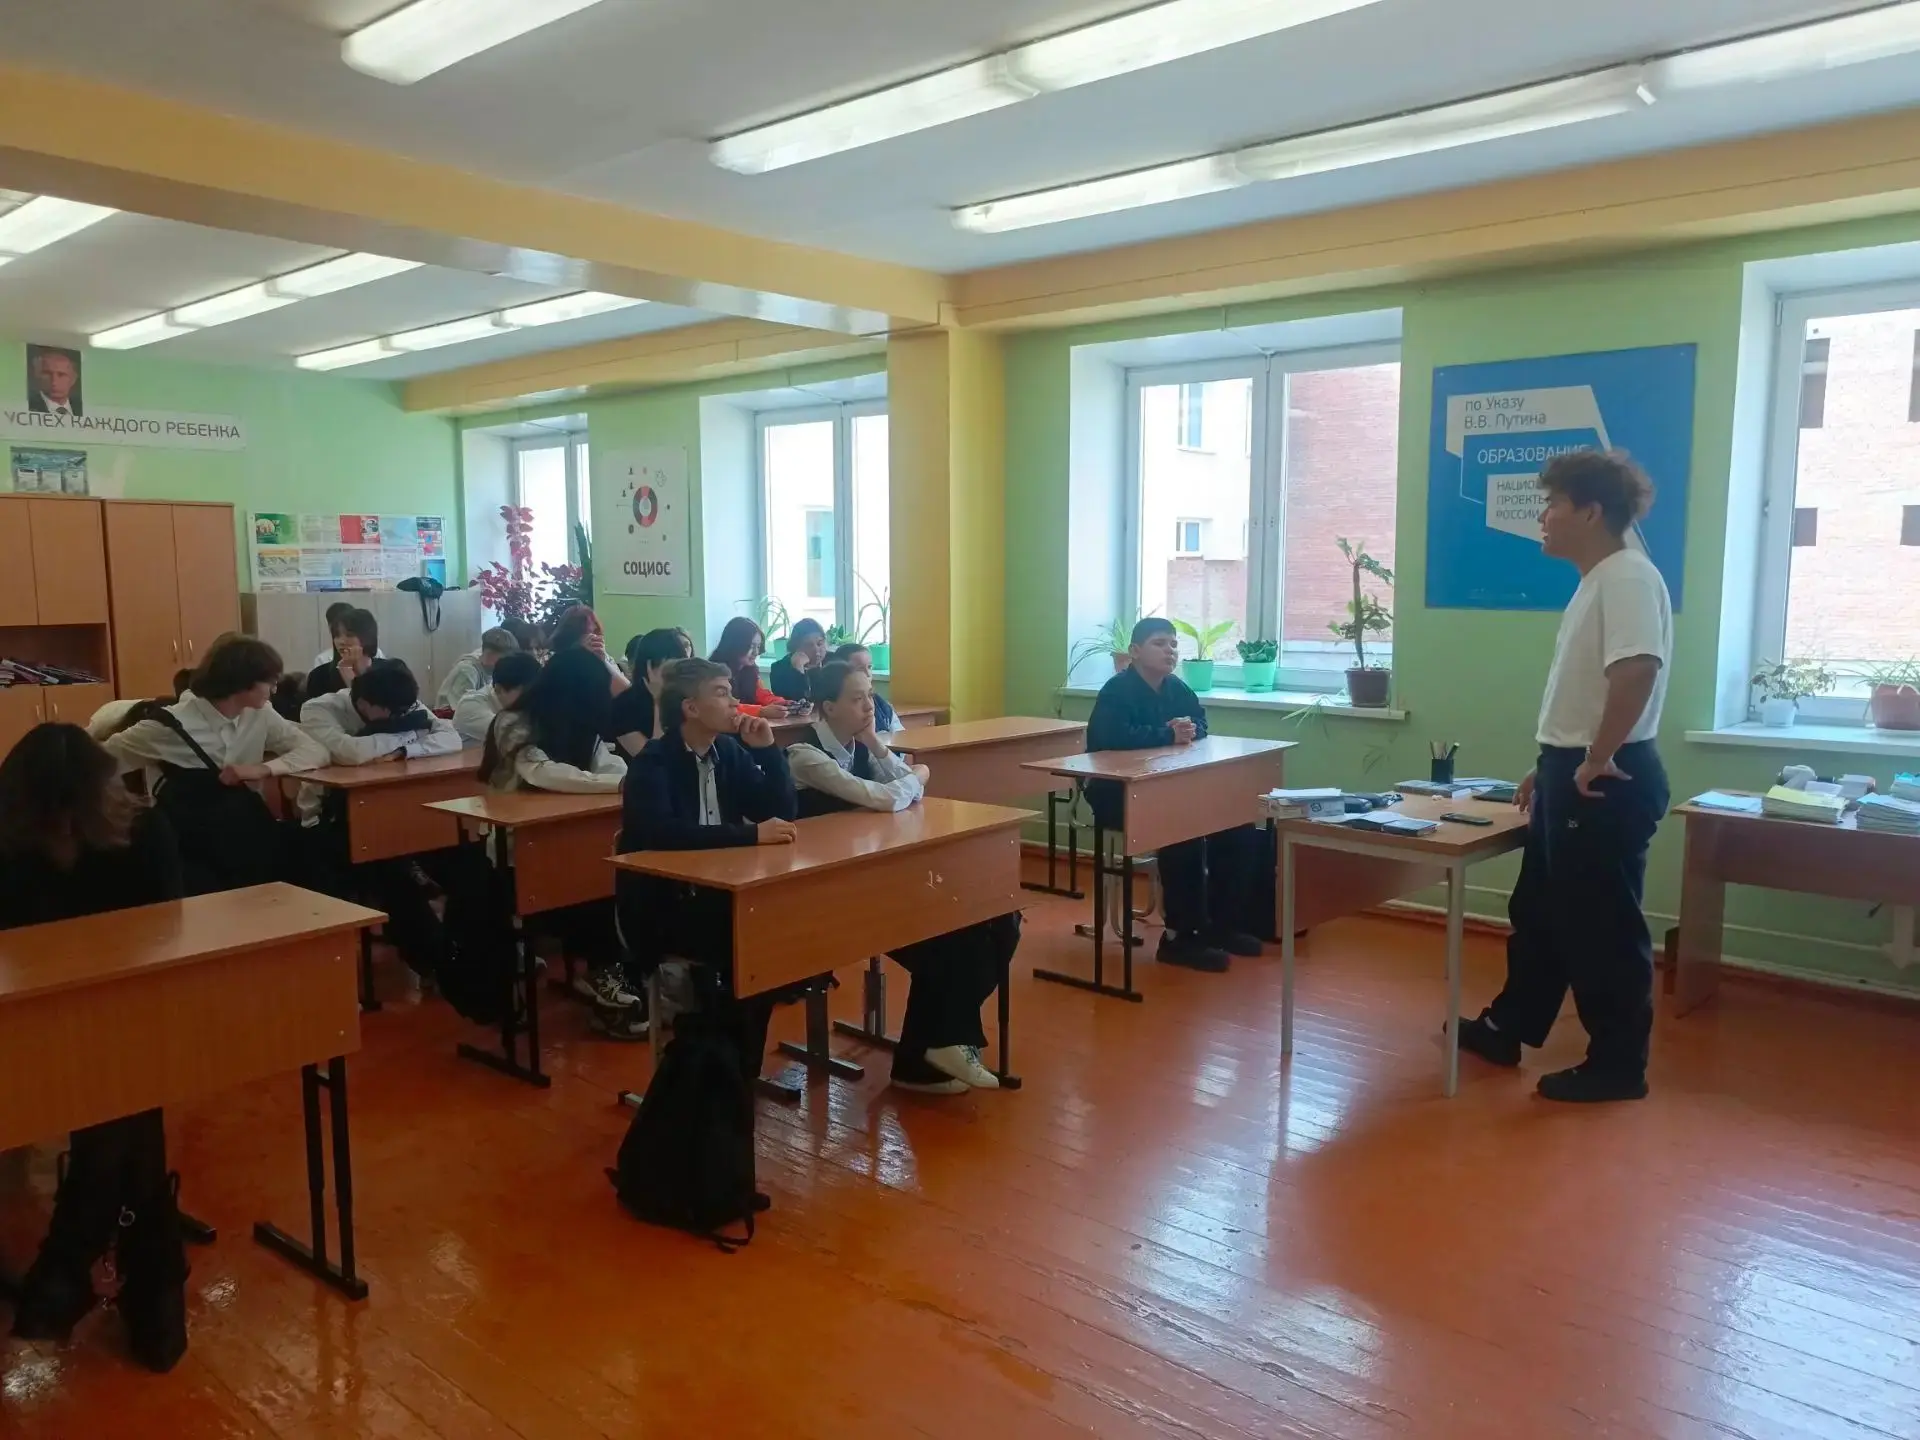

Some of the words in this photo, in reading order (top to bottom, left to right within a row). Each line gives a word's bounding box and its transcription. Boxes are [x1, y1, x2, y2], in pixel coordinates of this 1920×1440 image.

[1465, 400, 1482, 412] по
[1486, 396, 1525, 411] Указу
[4, 410, 65, 428] УСПЕХ
[71, 415, 160, 434] КАЖДОГО
[166, 421, 240, 439] РЕБЕНКА
[1496, 412, 1547, 430] Путина
[623, 561, 671, 578] СОЦИОС
